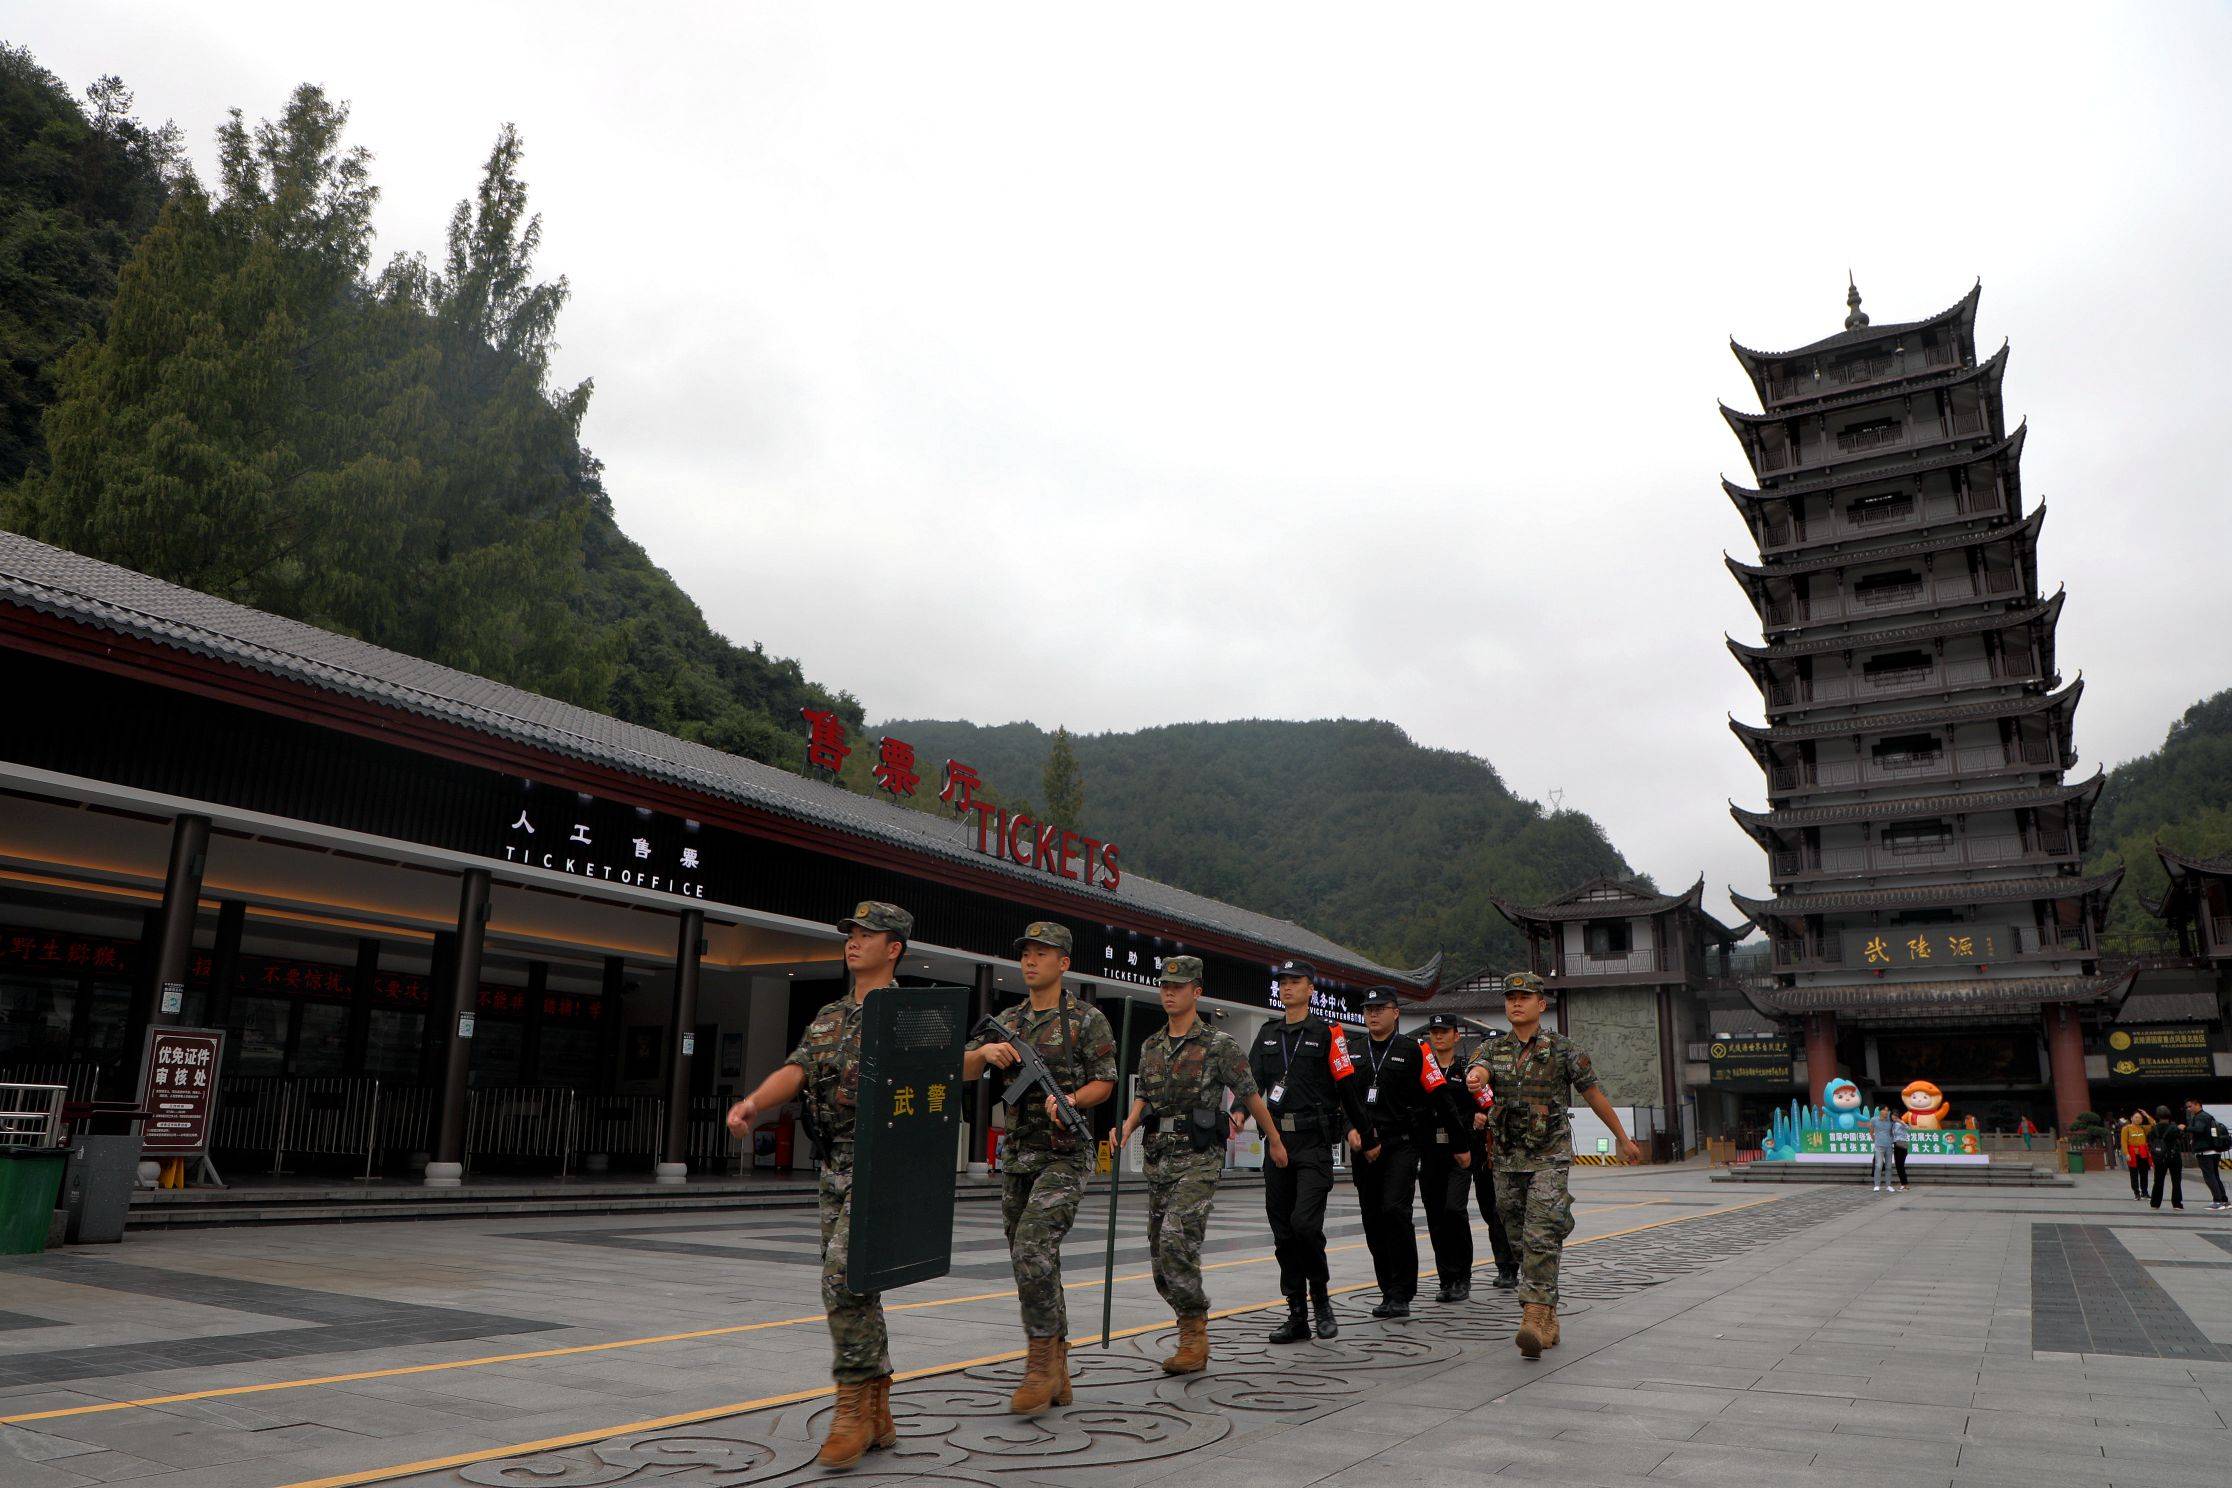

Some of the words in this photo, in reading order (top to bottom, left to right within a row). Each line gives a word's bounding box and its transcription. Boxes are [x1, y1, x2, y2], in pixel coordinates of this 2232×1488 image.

[800, 707, 982, 812] 售票厅
[512, 810, 700, 869] 人工售票
[971, 800, 1120, 892] TICKETS
[1864, 933, 1974, 963] 武陵源
[1308, 1006, 1323, 1016] VICE
[158, 1046, 210, 1066] 优免证件
[155, 1067, 207, 1087] 审核处
[893, 1083, 946, 1116] 武警
